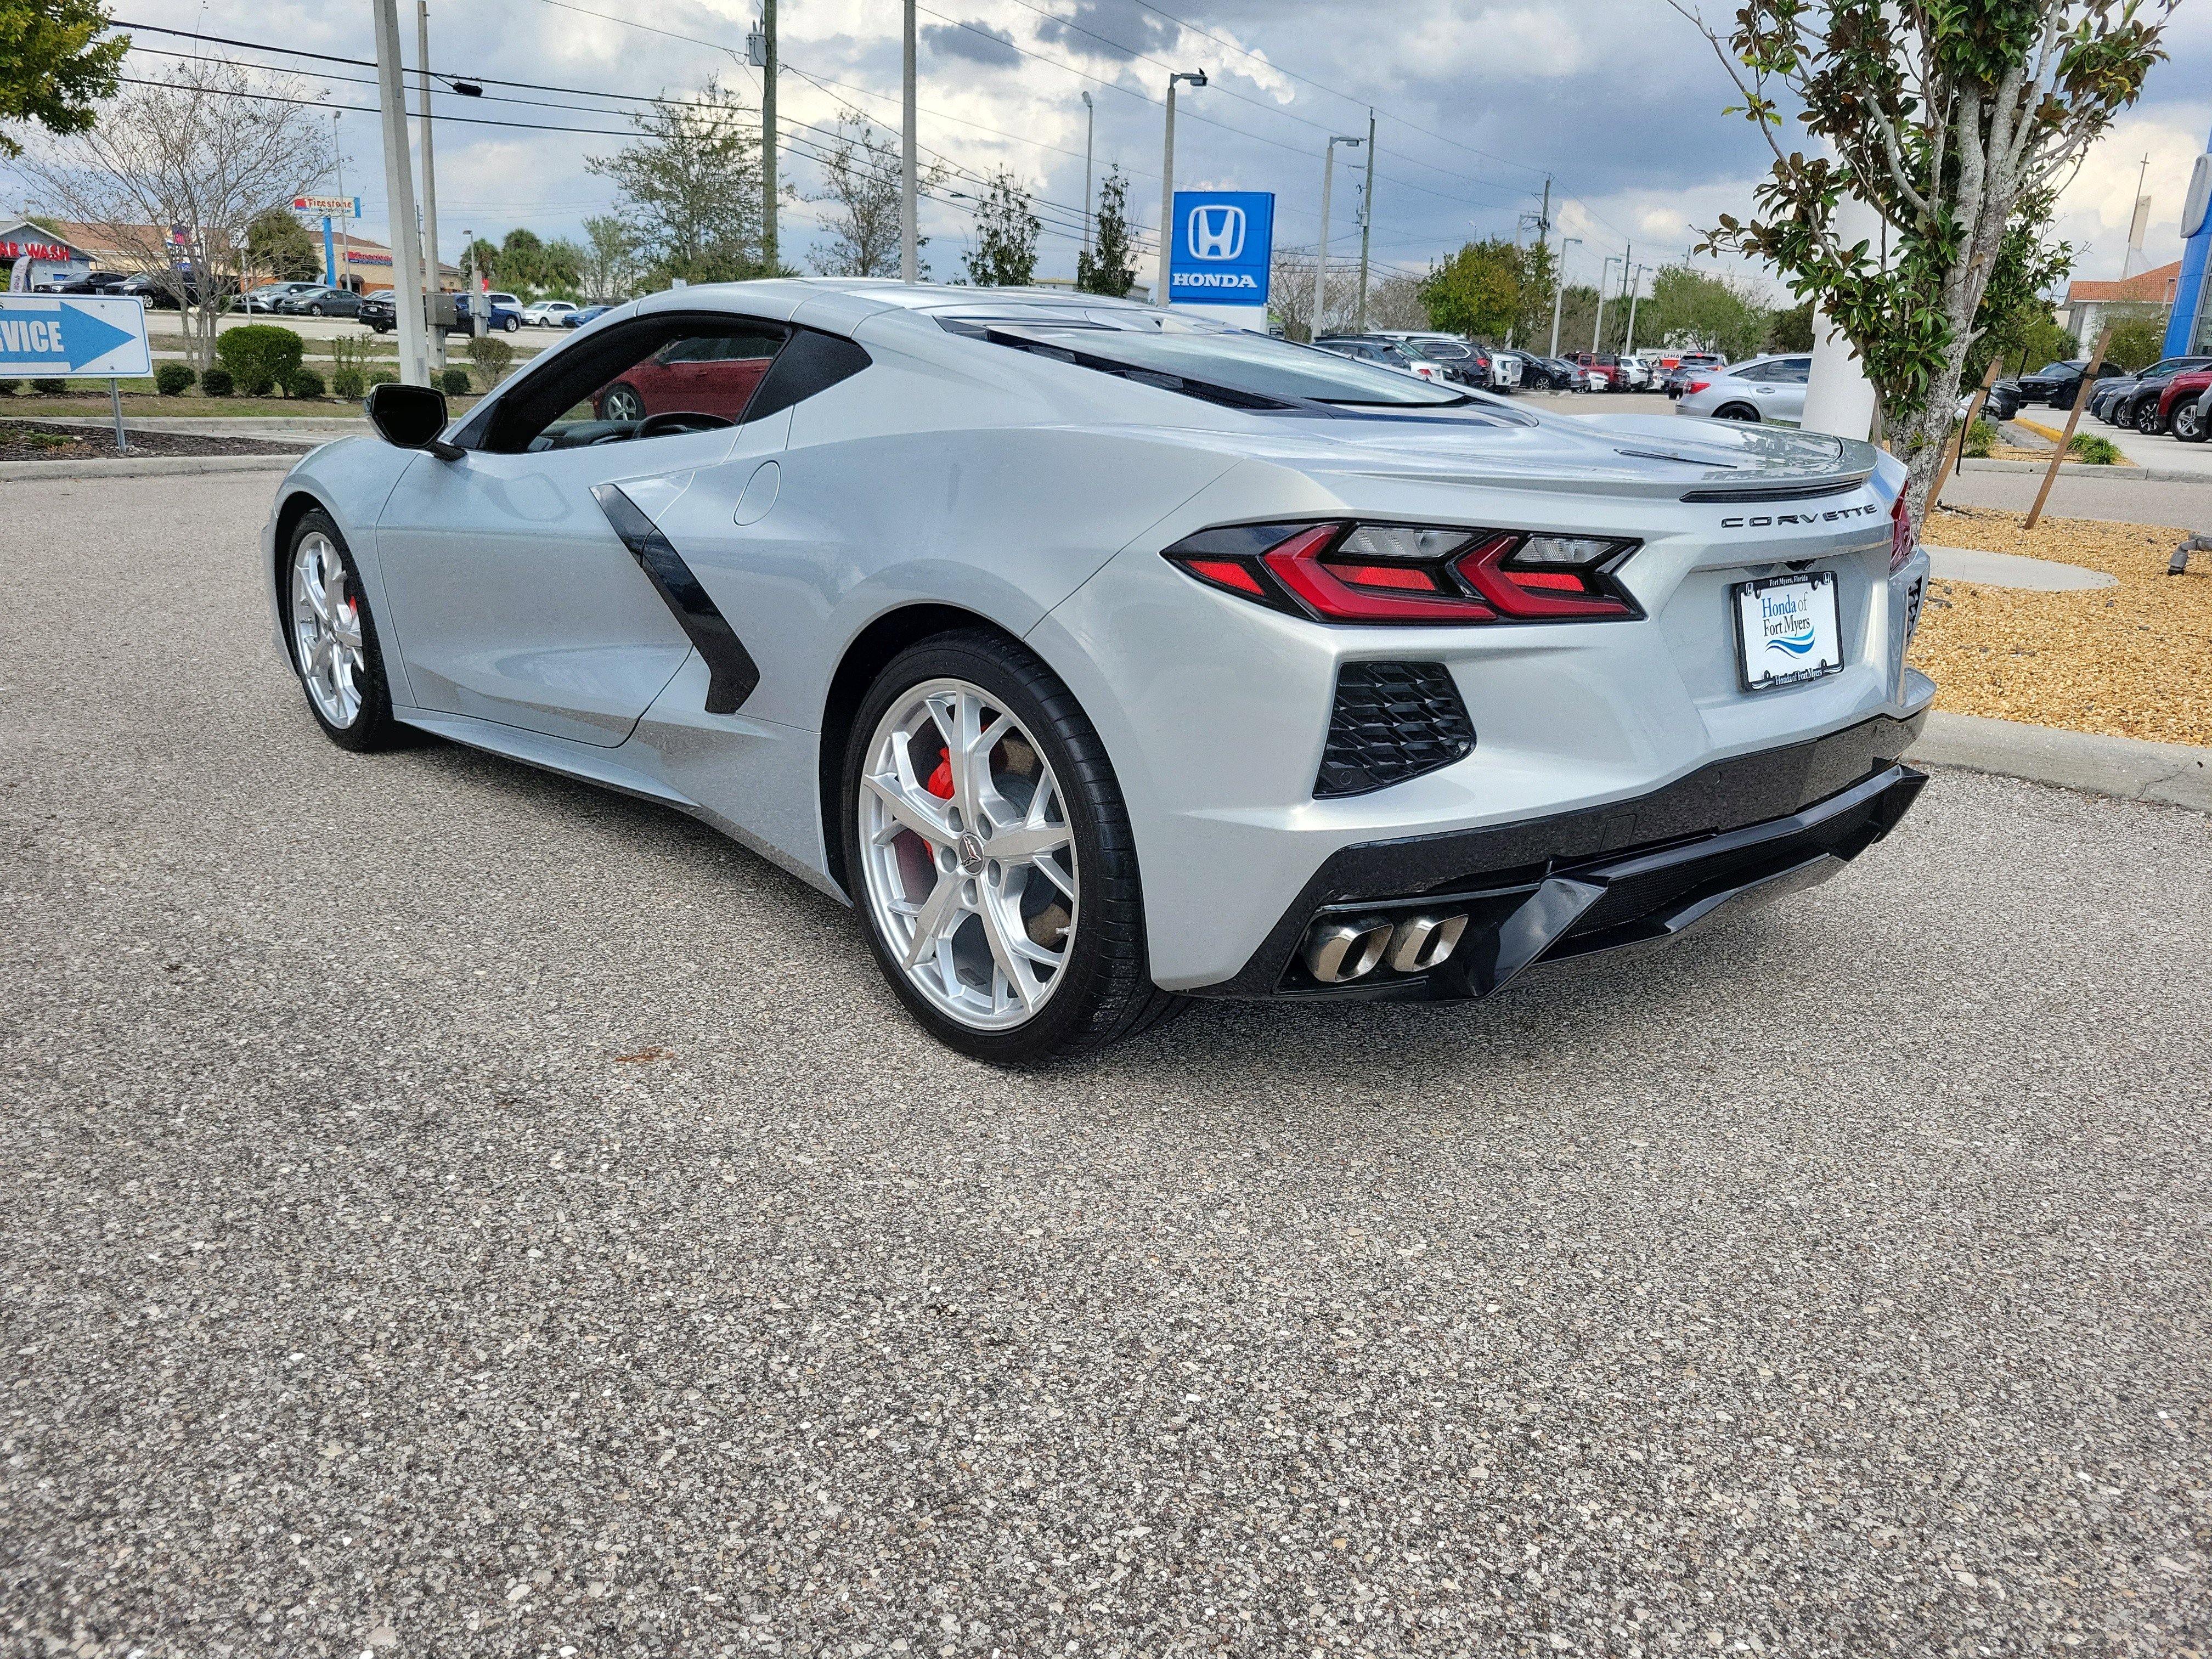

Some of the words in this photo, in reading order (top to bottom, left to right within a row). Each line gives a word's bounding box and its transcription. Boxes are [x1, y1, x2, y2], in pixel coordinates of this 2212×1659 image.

[308, 199, 352, 208] Firestone
[23, 242, 70, 261] WASH
[1172, 274, 1258, 288] HONDA
[1721, 504, 1877, 528] CORVETTE
[1779, 577, 1793, 586] Myers,
[1761, 594, 1797, 618] Honda
[1798, 591, 1808, 612] of
[1763, 619, 1782, 636] Fort
[1783, 614, 1810, 636] Myers
[1775, 673, 1792, 685] Honda
[1792, 673, 1798, 681] of
[1797, 671, 1808, 680] Fort
[1807, 669, 1822, 680] Myers
